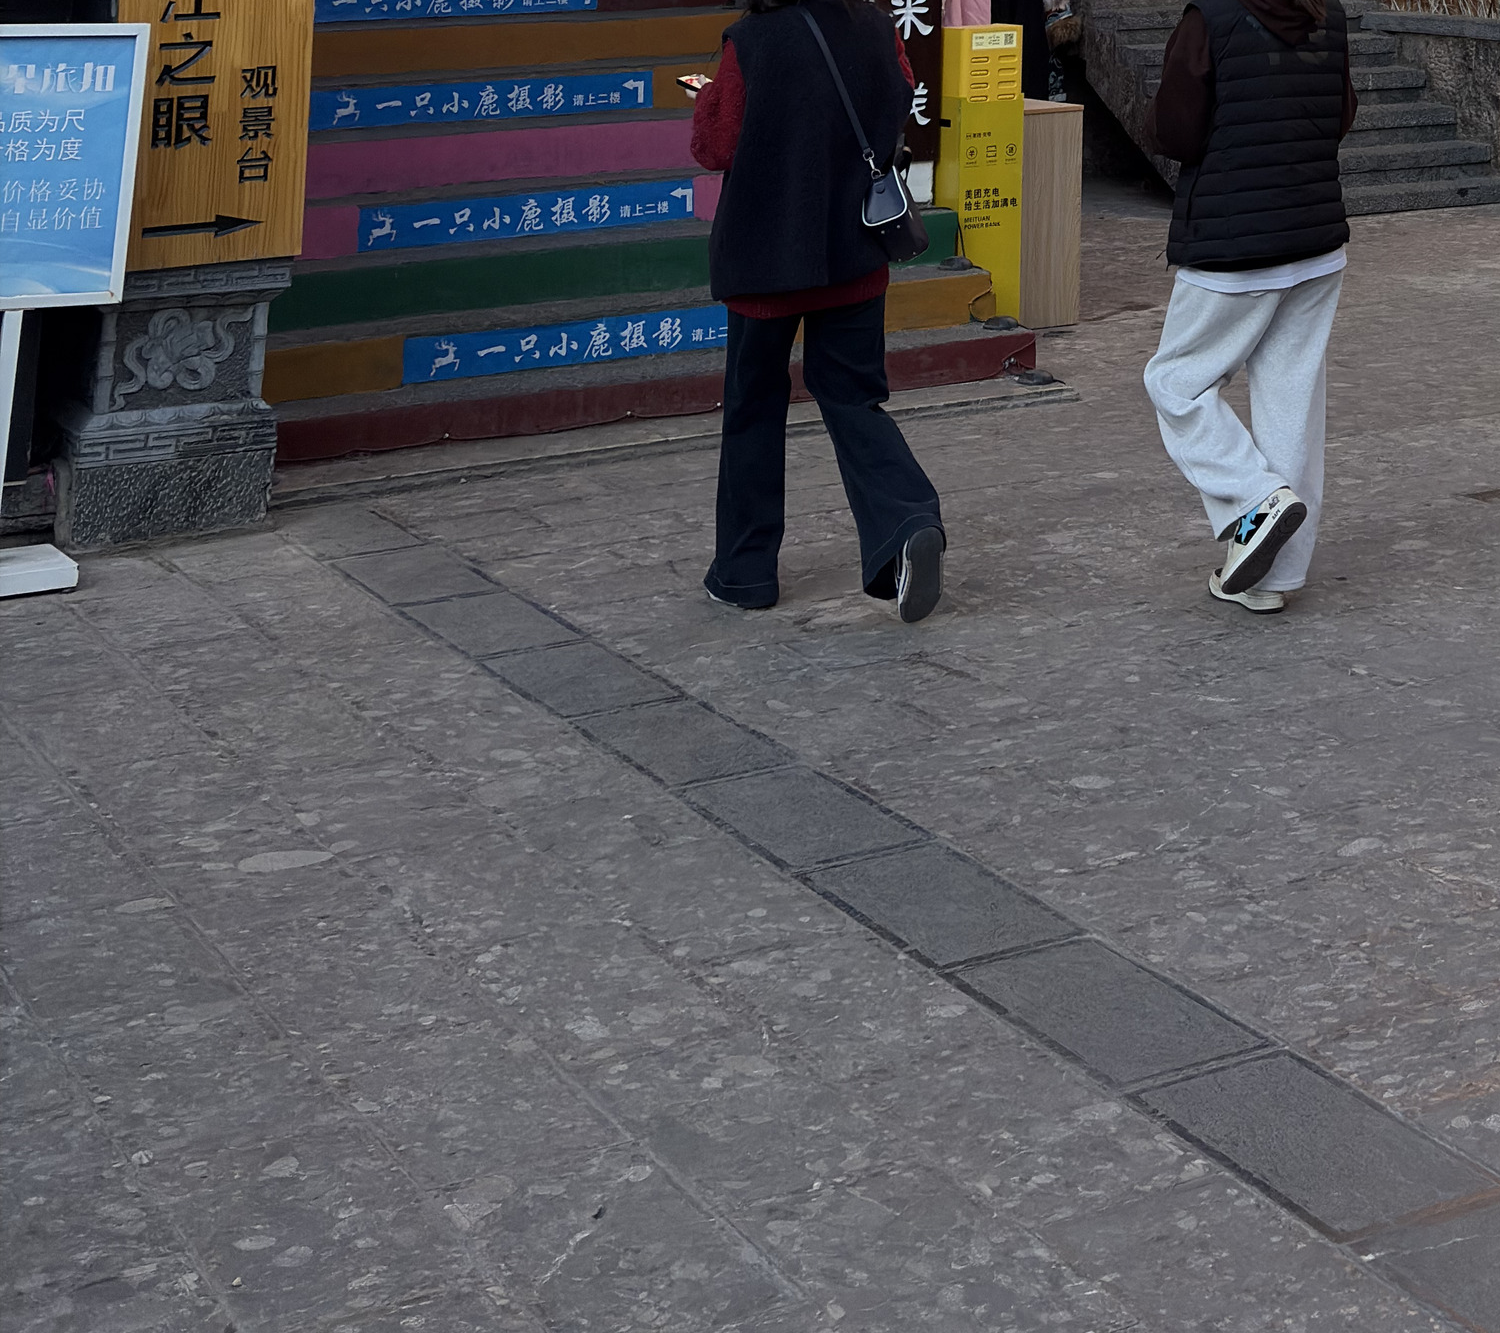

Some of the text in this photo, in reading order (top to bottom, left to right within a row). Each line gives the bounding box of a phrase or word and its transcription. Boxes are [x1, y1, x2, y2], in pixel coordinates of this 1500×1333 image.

[375, 83, 621, 118] 一只小鹿摄影 请上二楼
[237, 65, 279, 185] 观景台
[0, 137, 83, 162] 格为度
[3, 178, 106, 204] 价格妥协
[964, 187, 1000, 200] 美团充电
[964, 196, 1018, 211] 给生活加满电
[1, 206, 103, 233] 自显价值
[412, 193, 669, 235] 一只小鹿摄影 请上二楼
[964, 215, 991, 223] MEITUAN
[964, 221, 1001, 230] POWER BANK
[477, 316, 683, 363] 一只小鹿摄影
